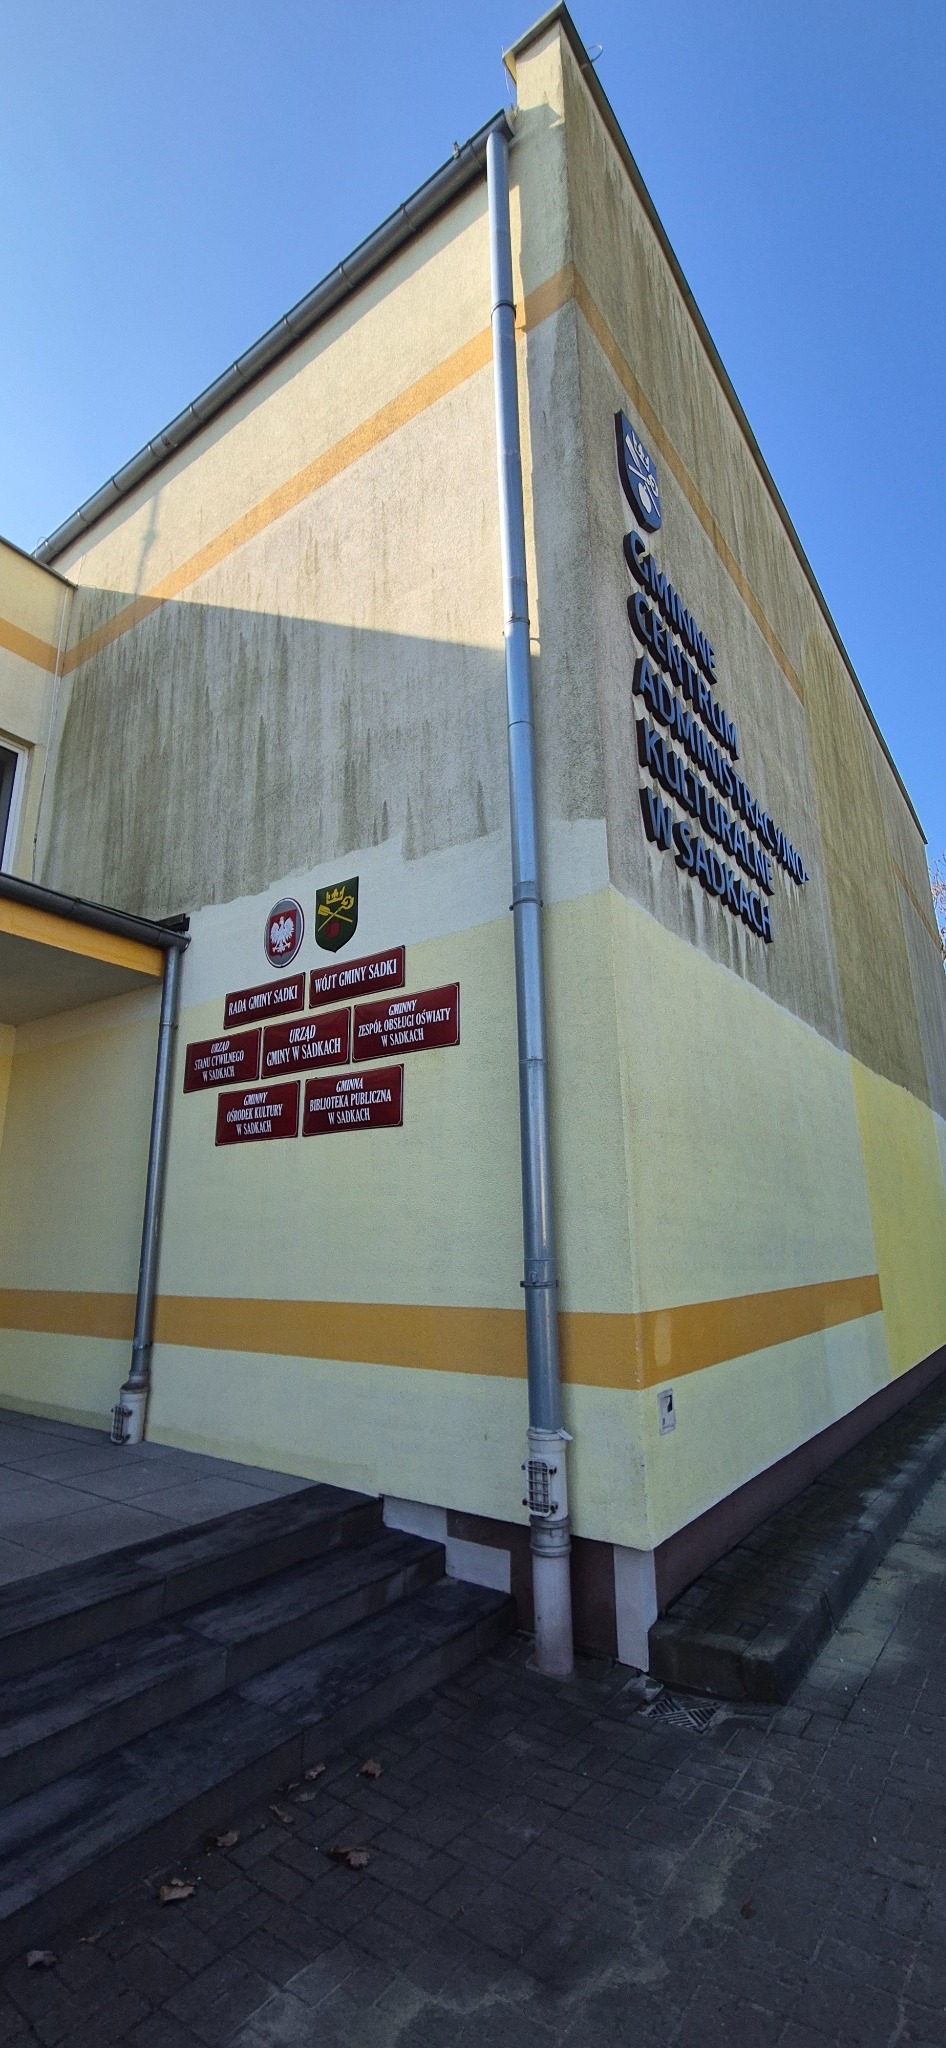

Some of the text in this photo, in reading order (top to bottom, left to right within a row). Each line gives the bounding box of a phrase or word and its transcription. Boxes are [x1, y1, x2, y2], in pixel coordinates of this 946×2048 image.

[624, 530, 717, 684] GMINNE
[628, 592, 739, 760] CENTRUM
[636, 719, 775, 894] KULTURALNE
[639, 787, 774, 943] W SADKACH
[315, 959, 397, 993] WÓJT GMINY SADKI
[229, 985, 298, 1016] RADA GMINY SADKI
[389, 1000, 417, 1015] GMINNY
[358, 1008, 450, 1037] ZESPÓŁ OBSŁUGI OŚWIATY
[289, 1025, 316, 1045] URZĄD
[381, 1029, 424, 1047] W SADKACH
[211, 1041, 229, 1054] URZĄD
[267, 1038, 341, 1066] GMINY W SADKACH
[194, 1050, 244, 1070] STANU CYWILNEGO
[203, 1066, 235, 1082] W SADKACH
[336, 1078, 363, 1093] GMINNA
[244, 1092, 268, 1106] GMINNY
[310, 1089, 391, 1112] BIBLIOTEKA PUBLICZNA
[227, 1104, 283, 1123] OŚRODEK KULTURY
[328, 1108, 370, 1124] W SADKACH
[236, 1120, 272, 1136] W SADKACH
